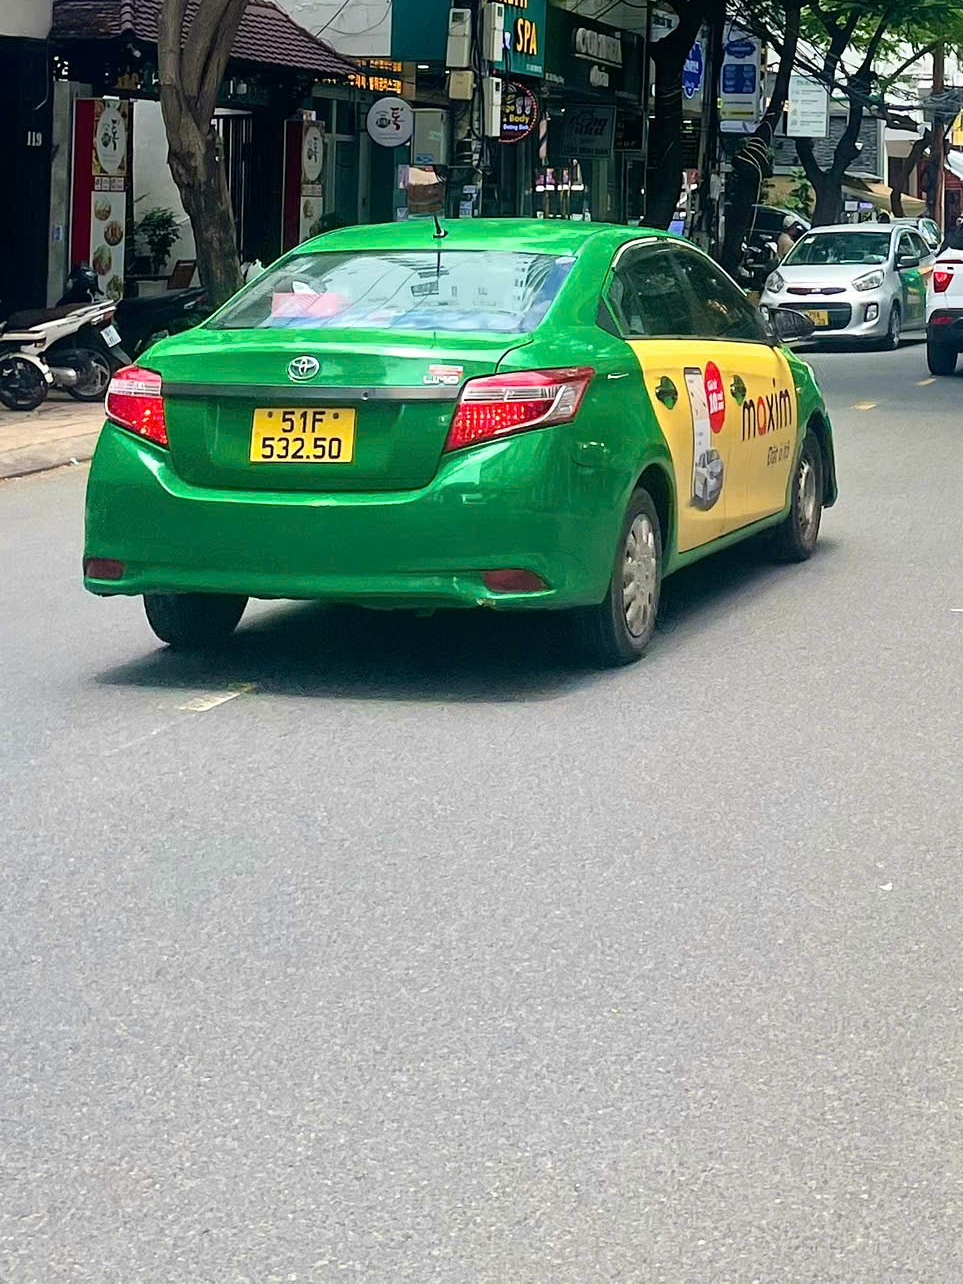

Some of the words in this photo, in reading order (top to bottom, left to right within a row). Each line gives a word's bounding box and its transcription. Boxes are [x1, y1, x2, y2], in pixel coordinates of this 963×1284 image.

[516, 18, 538, 56] SPA
[26, 131, 42, 147] 119
[281, 411, 326, 434] 51F
[261, 437, 342, 460] 532.50
